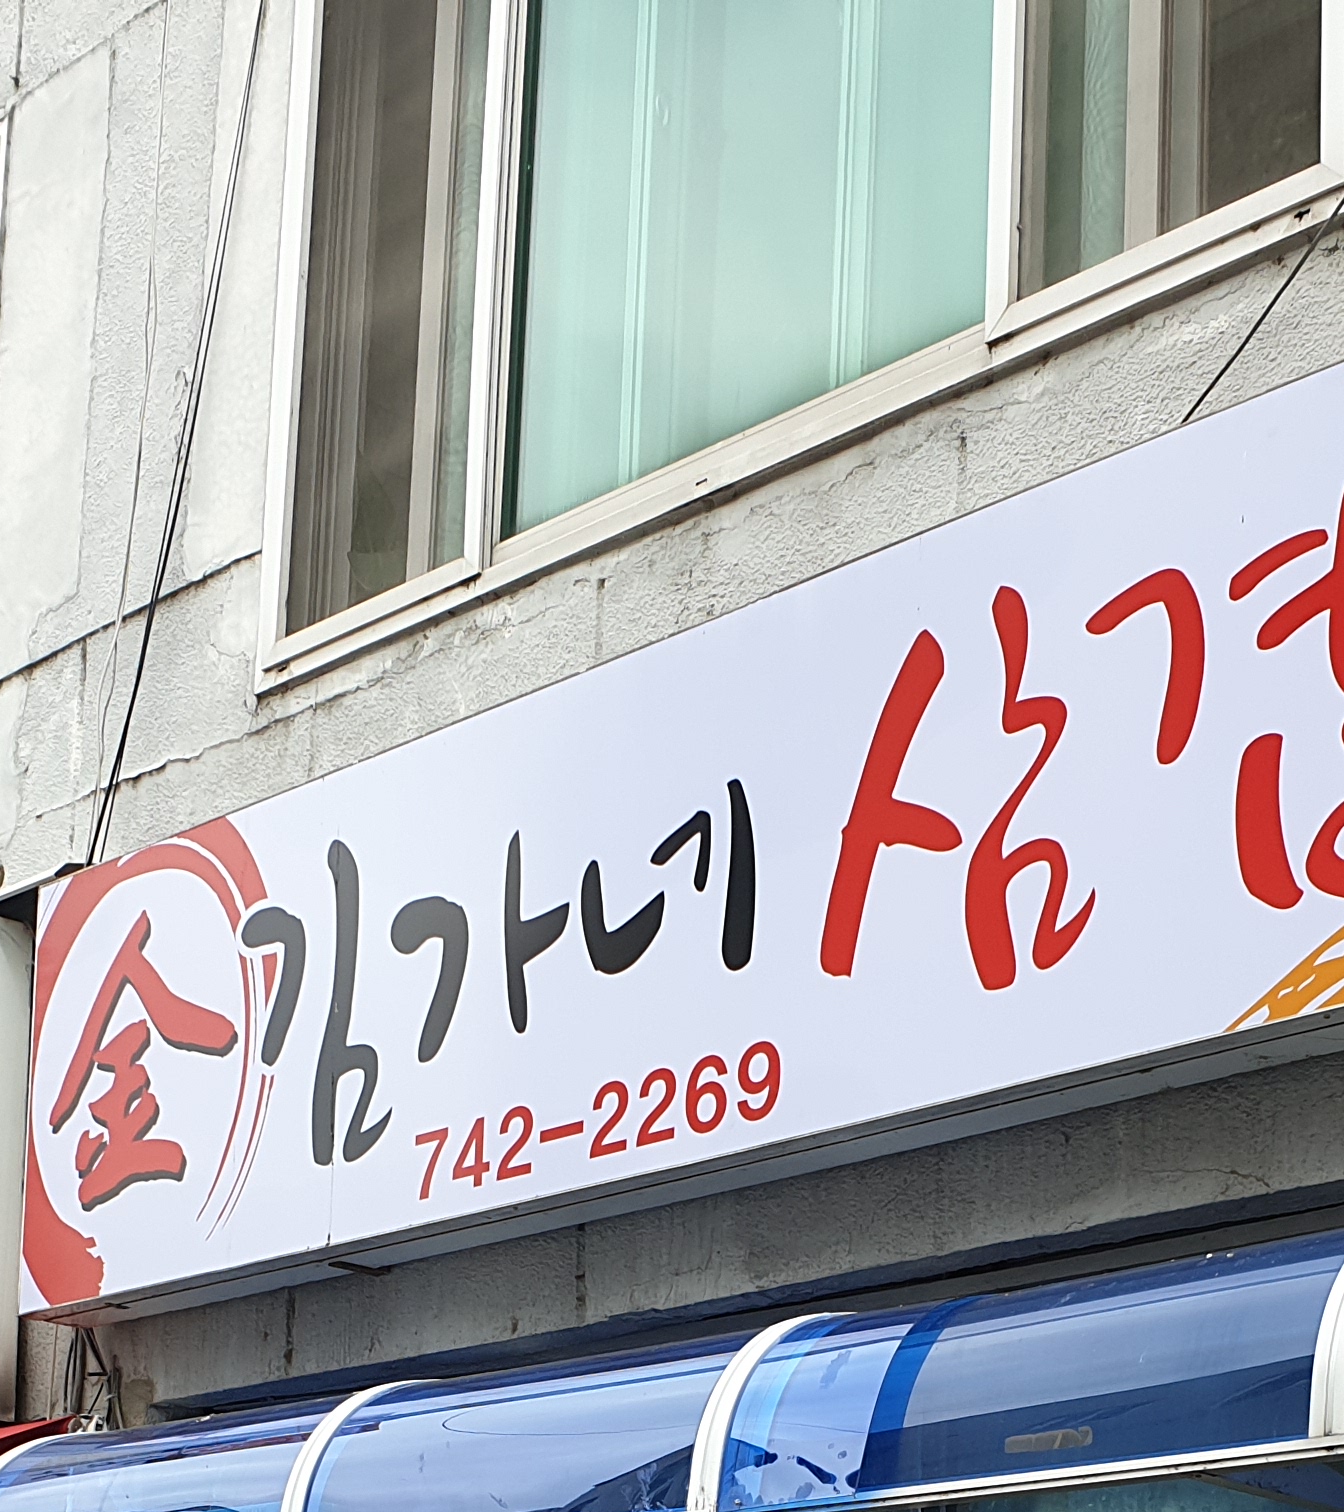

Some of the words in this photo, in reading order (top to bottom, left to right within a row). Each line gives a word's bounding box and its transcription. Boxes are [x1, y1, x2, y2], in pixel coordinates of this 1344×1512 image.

[50, 910, 239, 1212] 金
[241, 779, 756, 1165] 김가네
[416, 1041, 780, 1200] 742-2269
